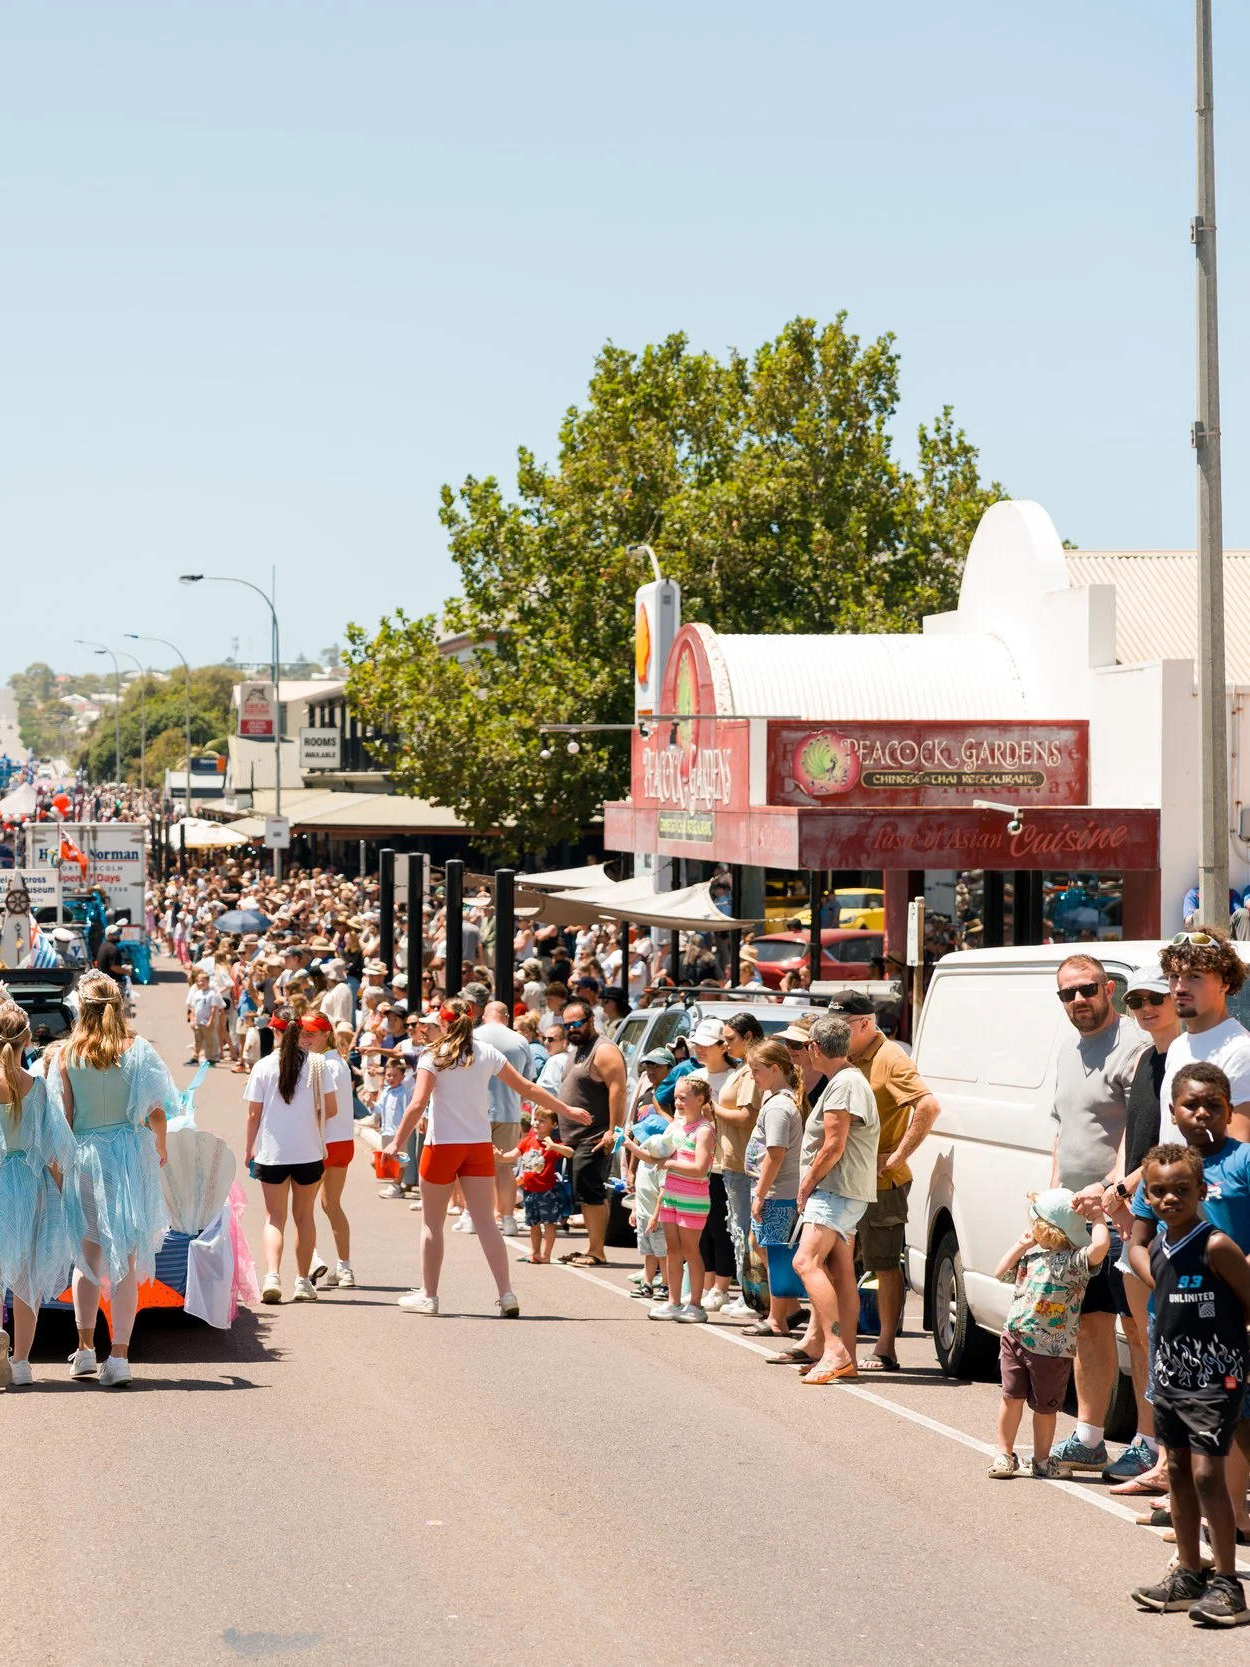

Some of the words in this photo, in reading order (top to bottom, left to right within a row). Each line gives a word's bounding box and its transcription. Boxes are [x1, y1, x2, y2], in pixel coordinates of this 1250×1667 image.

[304, 737, 337, 747] ROOMS
[840, 738, 960, 769] PEACOCK
[961, 738, 1062, 772] GARDENS
[872, 774, 920, 784] CHINESE
[931, 774, 957, 784] THAI
[962, 774, 1037, 784] RESTAURANT
[873, 826, 919, 849] Taste
[924, 826, 948, 851] of
[945, 827, 1003, 849] Asian
[1010, 820, 1129, 858] Cuisine
[90, 848, 139, 860] Norman
[97, 874, 121, 884] Days
[1177, 1275, 1203, 1289] 93
[1168, 1291, 1215, 1303] UNLIMITED
